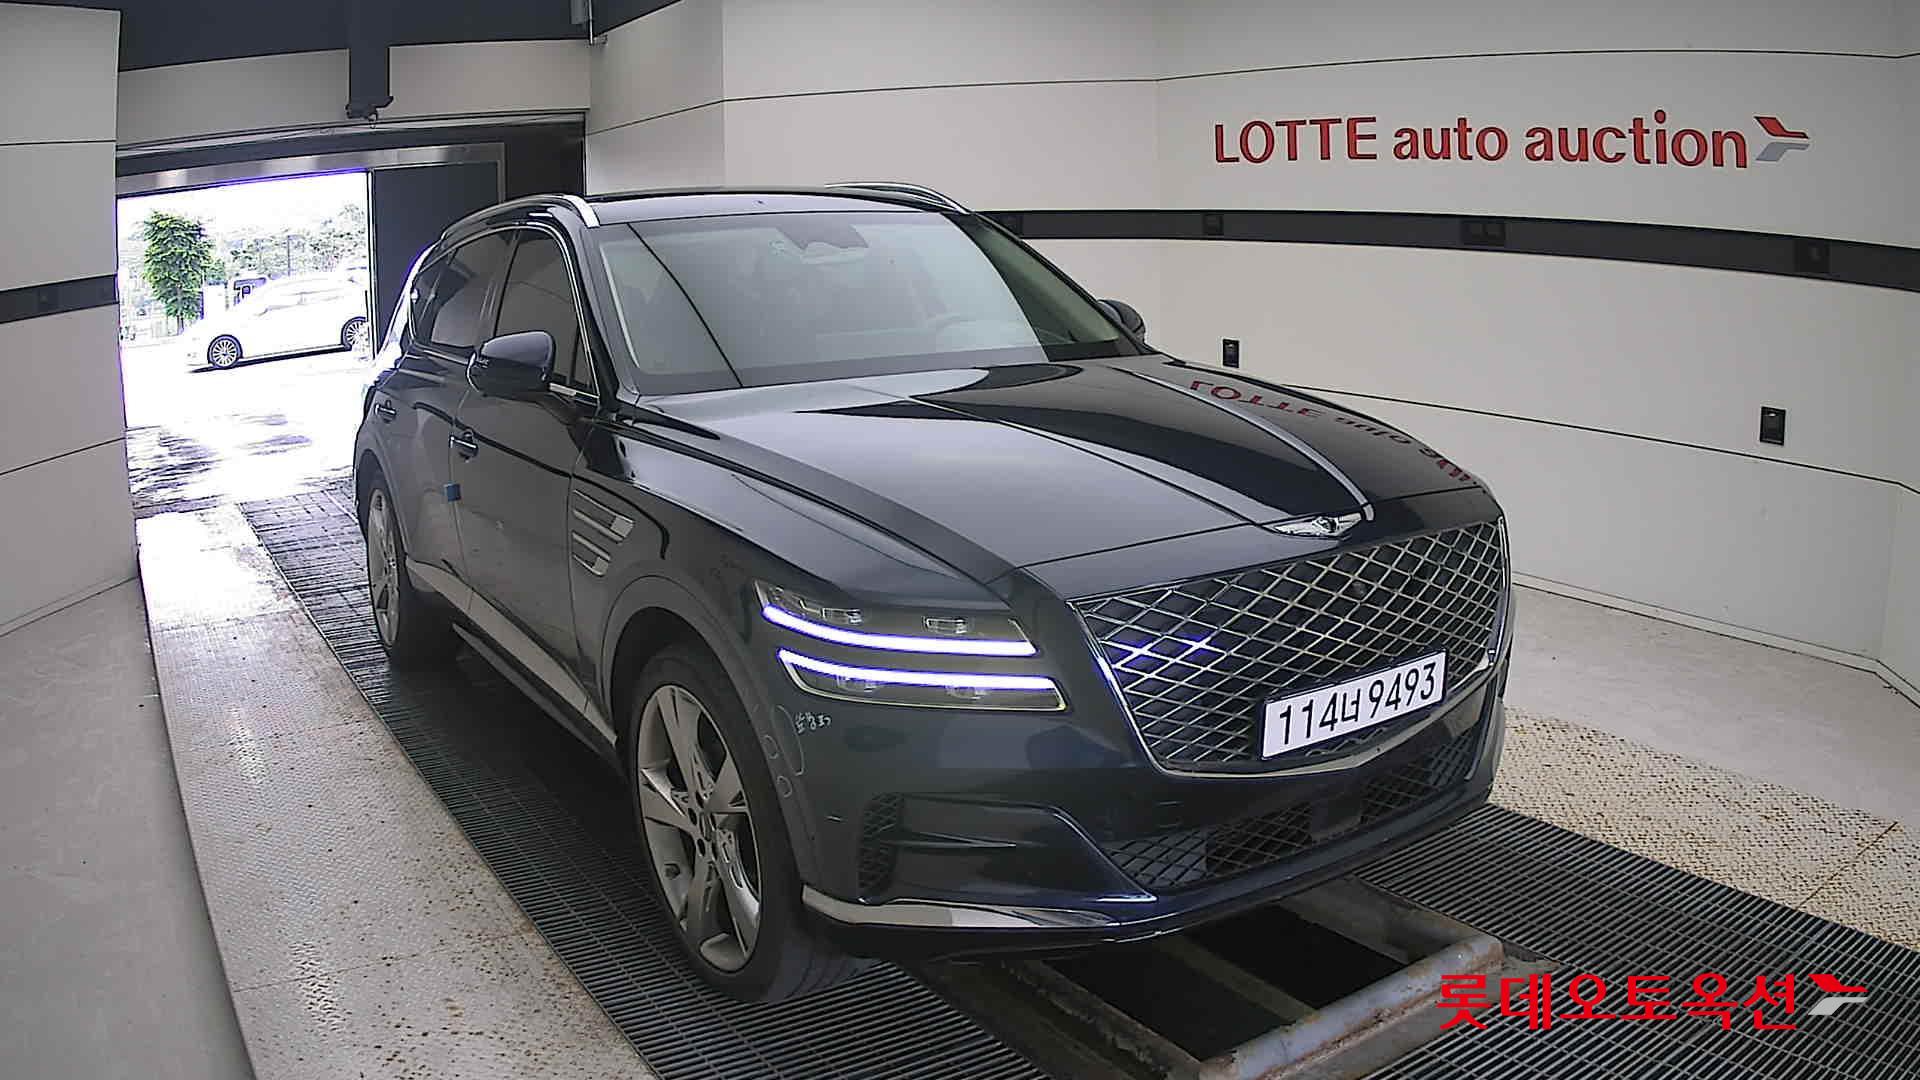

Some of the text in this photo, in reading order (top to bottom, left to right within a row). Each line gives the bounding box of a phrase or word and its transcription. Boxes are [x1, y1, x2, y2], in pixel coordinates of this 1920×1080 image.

[1215, 110, 1749, 169] LOTTE auto auction
